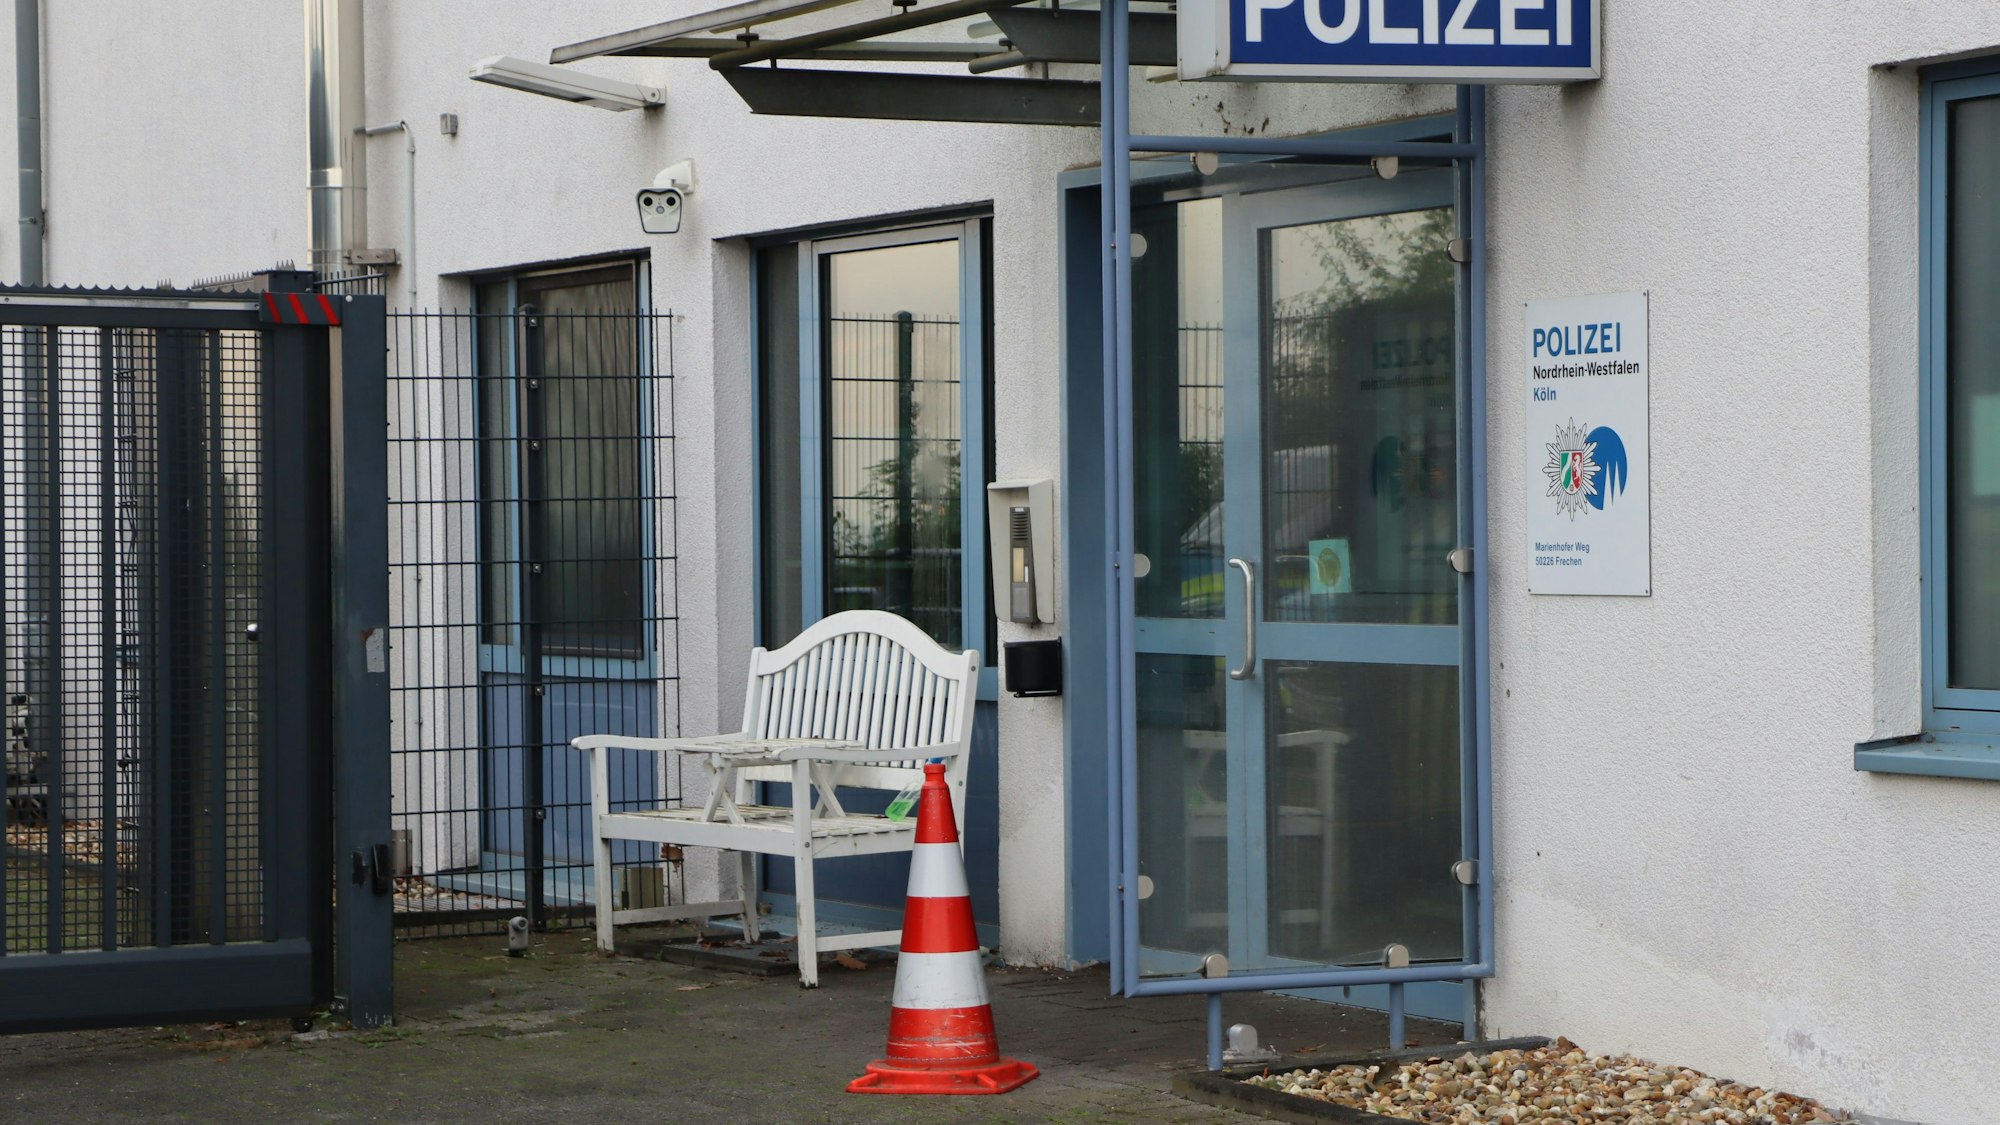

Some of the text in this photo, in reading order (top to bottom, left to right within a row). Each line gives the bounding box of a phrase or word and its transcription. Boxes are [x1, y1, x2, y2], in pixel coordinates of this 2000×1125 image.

[1245, 0, 1572, 46] POLIZEI
[1533, 322, 1621, 358] POLIZEI
[1533, 360, 1640, 380] Nordrhein-Westfalen
[1533, 387, 1557, 402] Köln
[1535, 542, 1590, 554] Marienhofer Weg
[1535, 556, 1582, 566] 50226 Frechen
